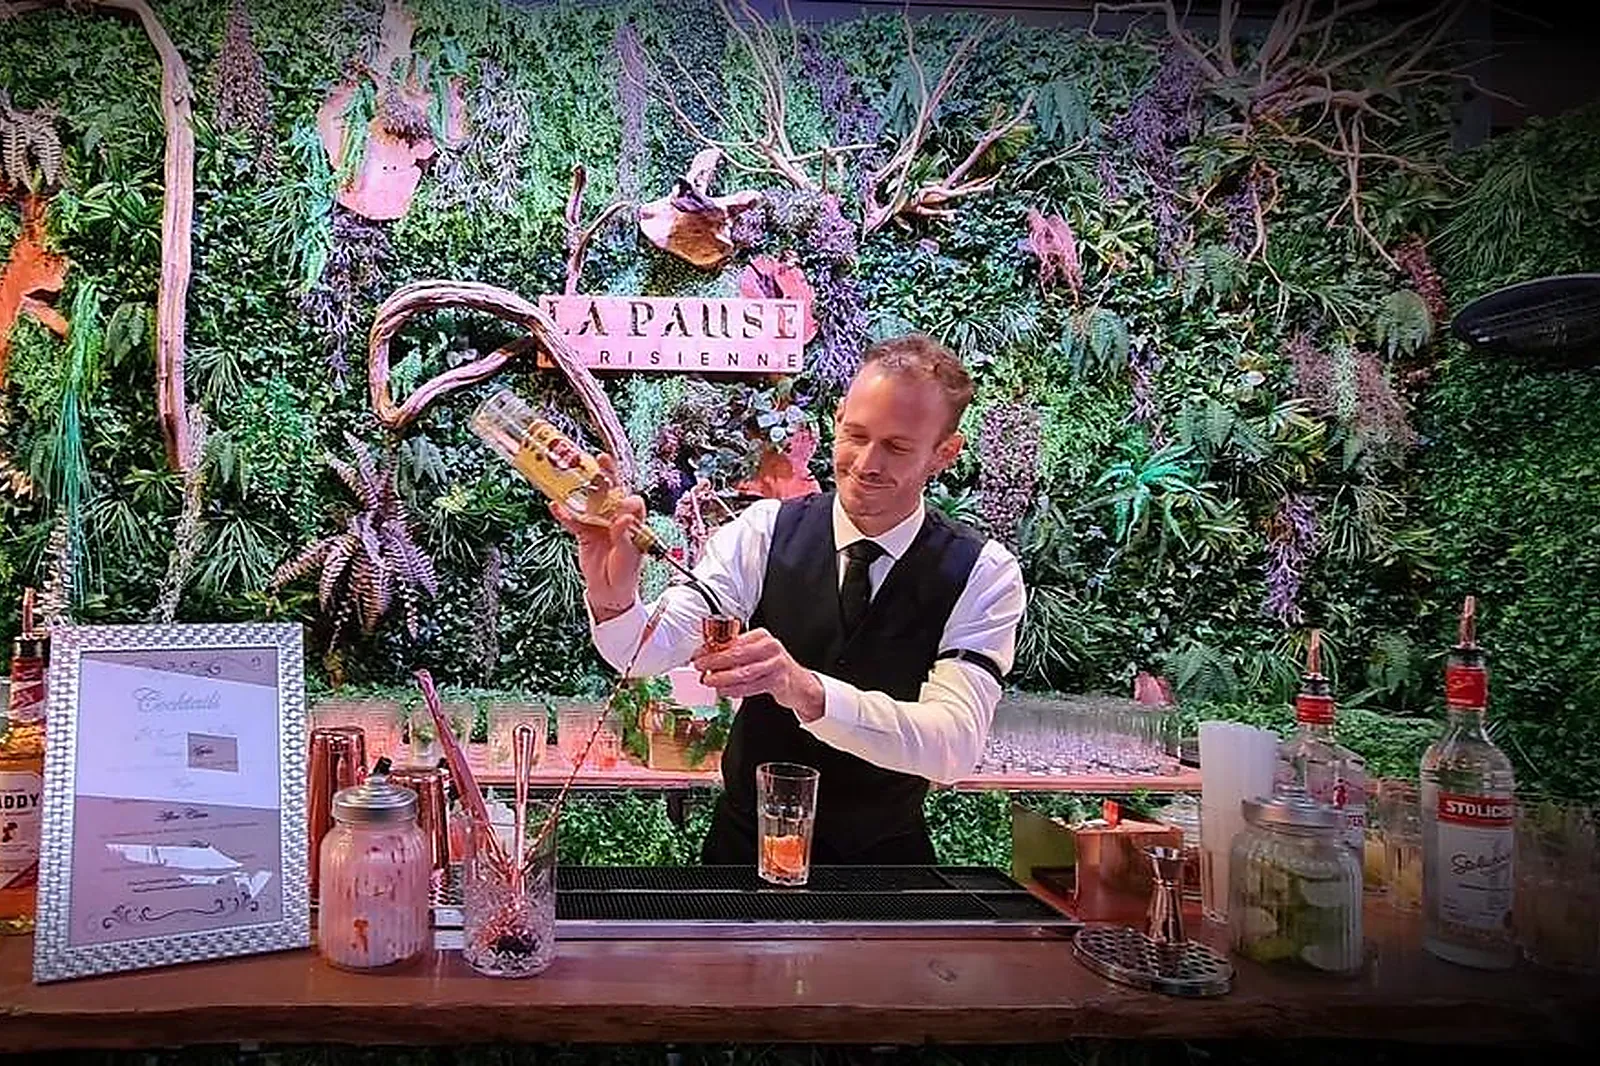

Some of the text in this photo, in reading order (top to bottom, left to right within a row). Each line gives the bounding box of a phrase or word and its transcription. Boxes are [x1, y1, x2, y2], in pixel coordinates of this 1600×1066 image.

[627, 302, 798, 339] PAUSE
[541, 348, 798, 368] RISIENNE
[0, 792, 40, 809] DDY
